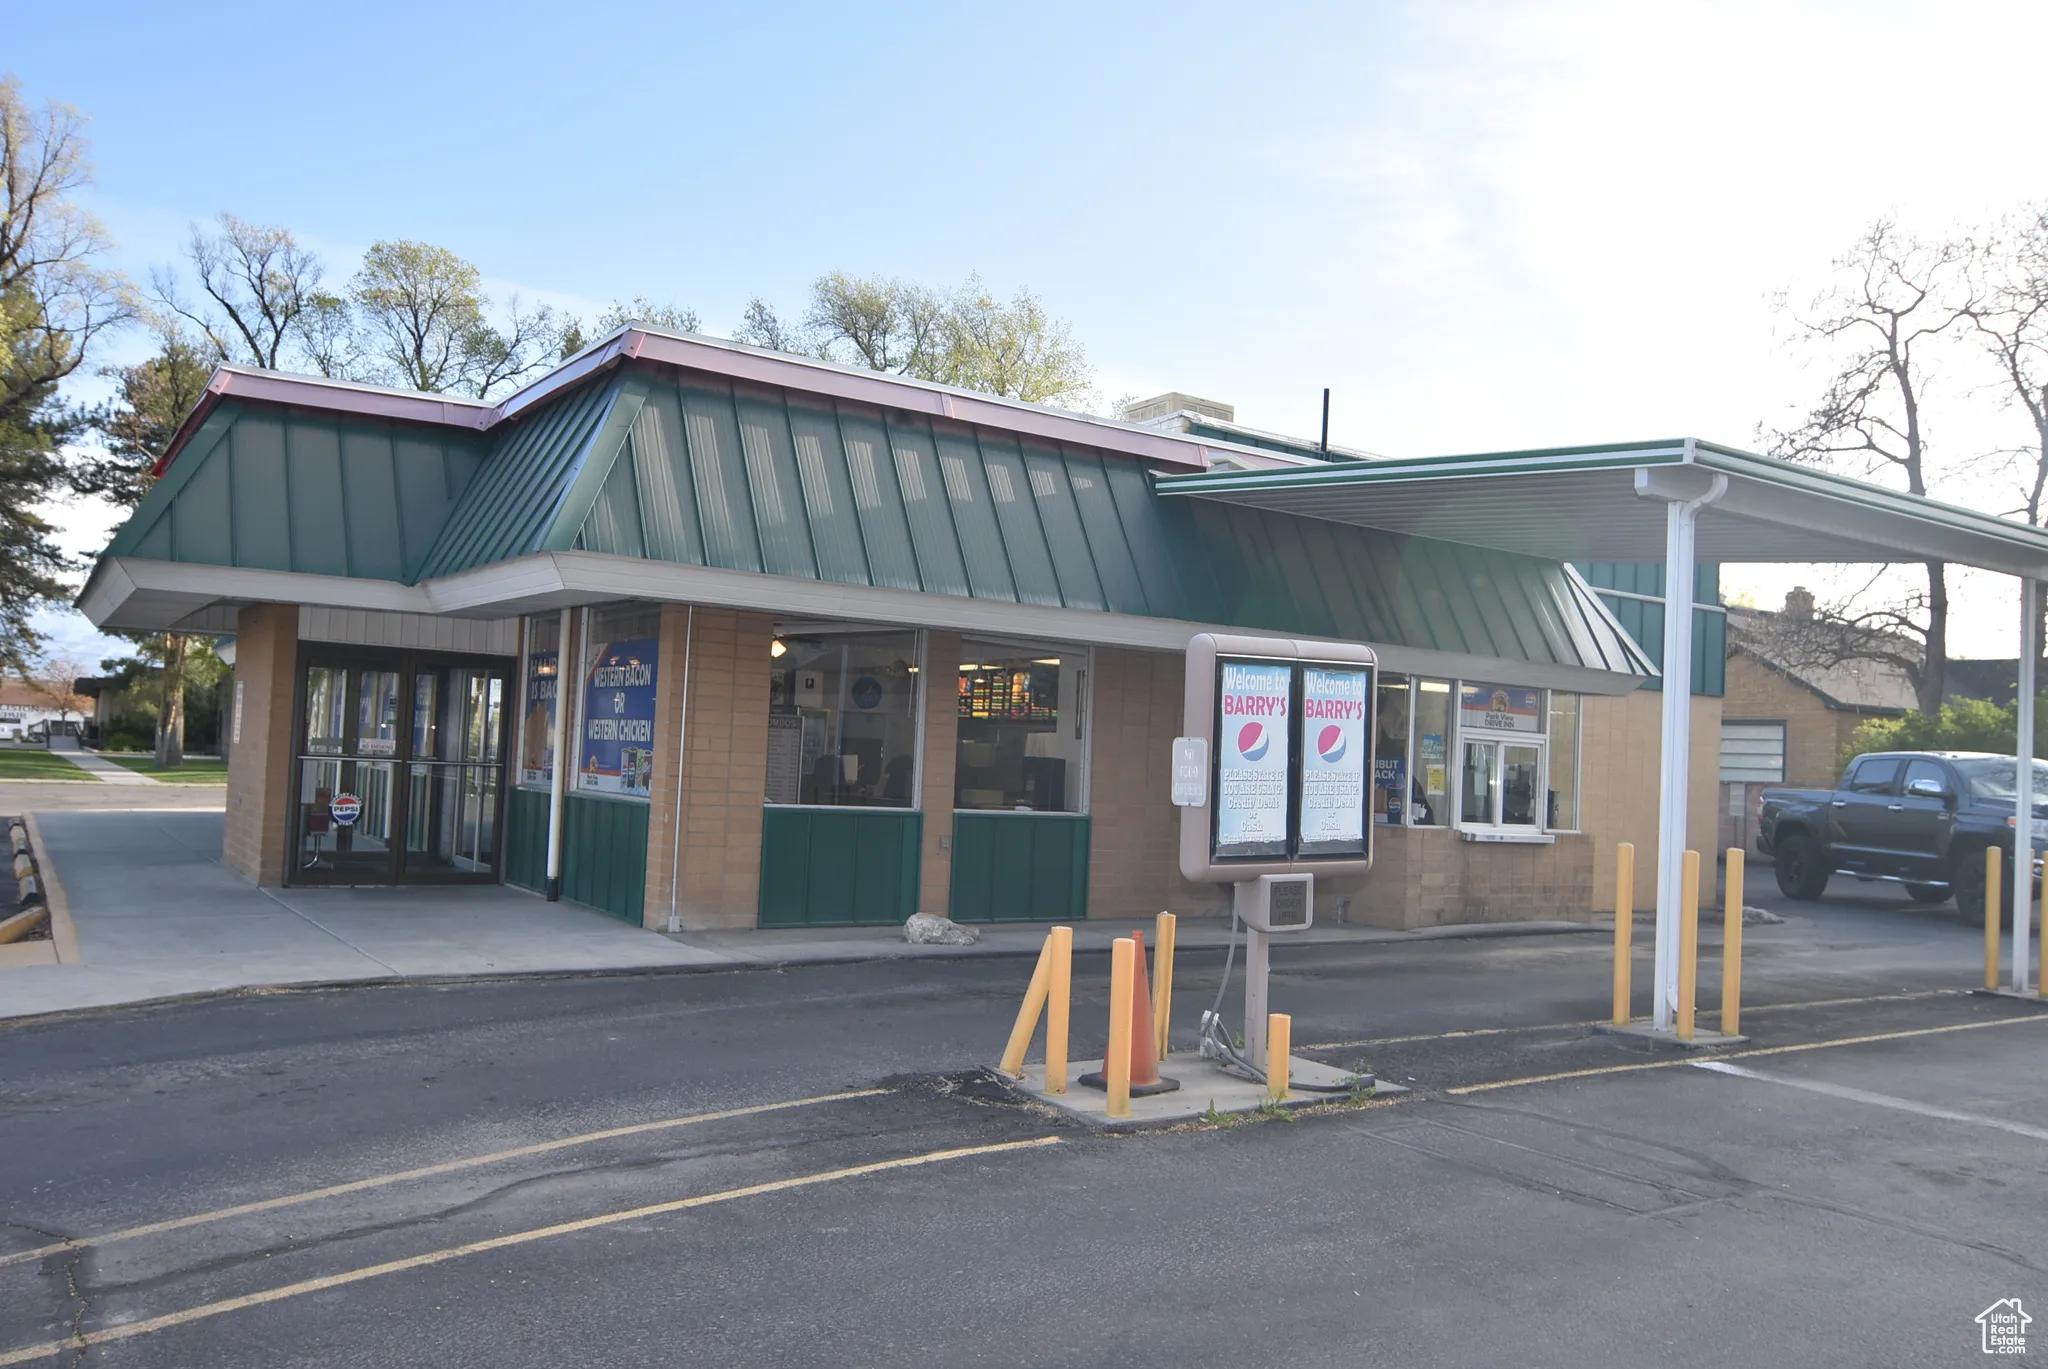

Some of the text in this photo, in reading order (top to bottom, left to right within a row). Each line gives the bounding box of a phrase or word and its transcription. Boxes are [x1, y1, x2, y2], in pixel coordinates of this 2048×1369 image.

[594, 664, 651, 687] WESTERN BACON
[1225, 667, 1286, 691] Welcome to
[1306, 671, 1362, 695] Welcome to
[531, 681, 539, 699] IS
[614, 692, 625, 714] OR
[1224, 694, 1286, 716] BARRY'S
[1305, 698, 1362, 720] BARRY'S
[1485, 719, 1502, 727] DRIVE
[1486, 712, 1514, 721] Park View
[588, 719, 650, 742] WESTERN CHICKEN
[1224, 768, 1253, 782] PLEASE
[1305, 770, 1331, 782] PLEASE
[1224, 783, 1239, 795] YOU
[1240, 783, 1256, 795] ARE
[1241, 820, 1263, 832] Cash
[1320, 820, 1341, 831] Cash
